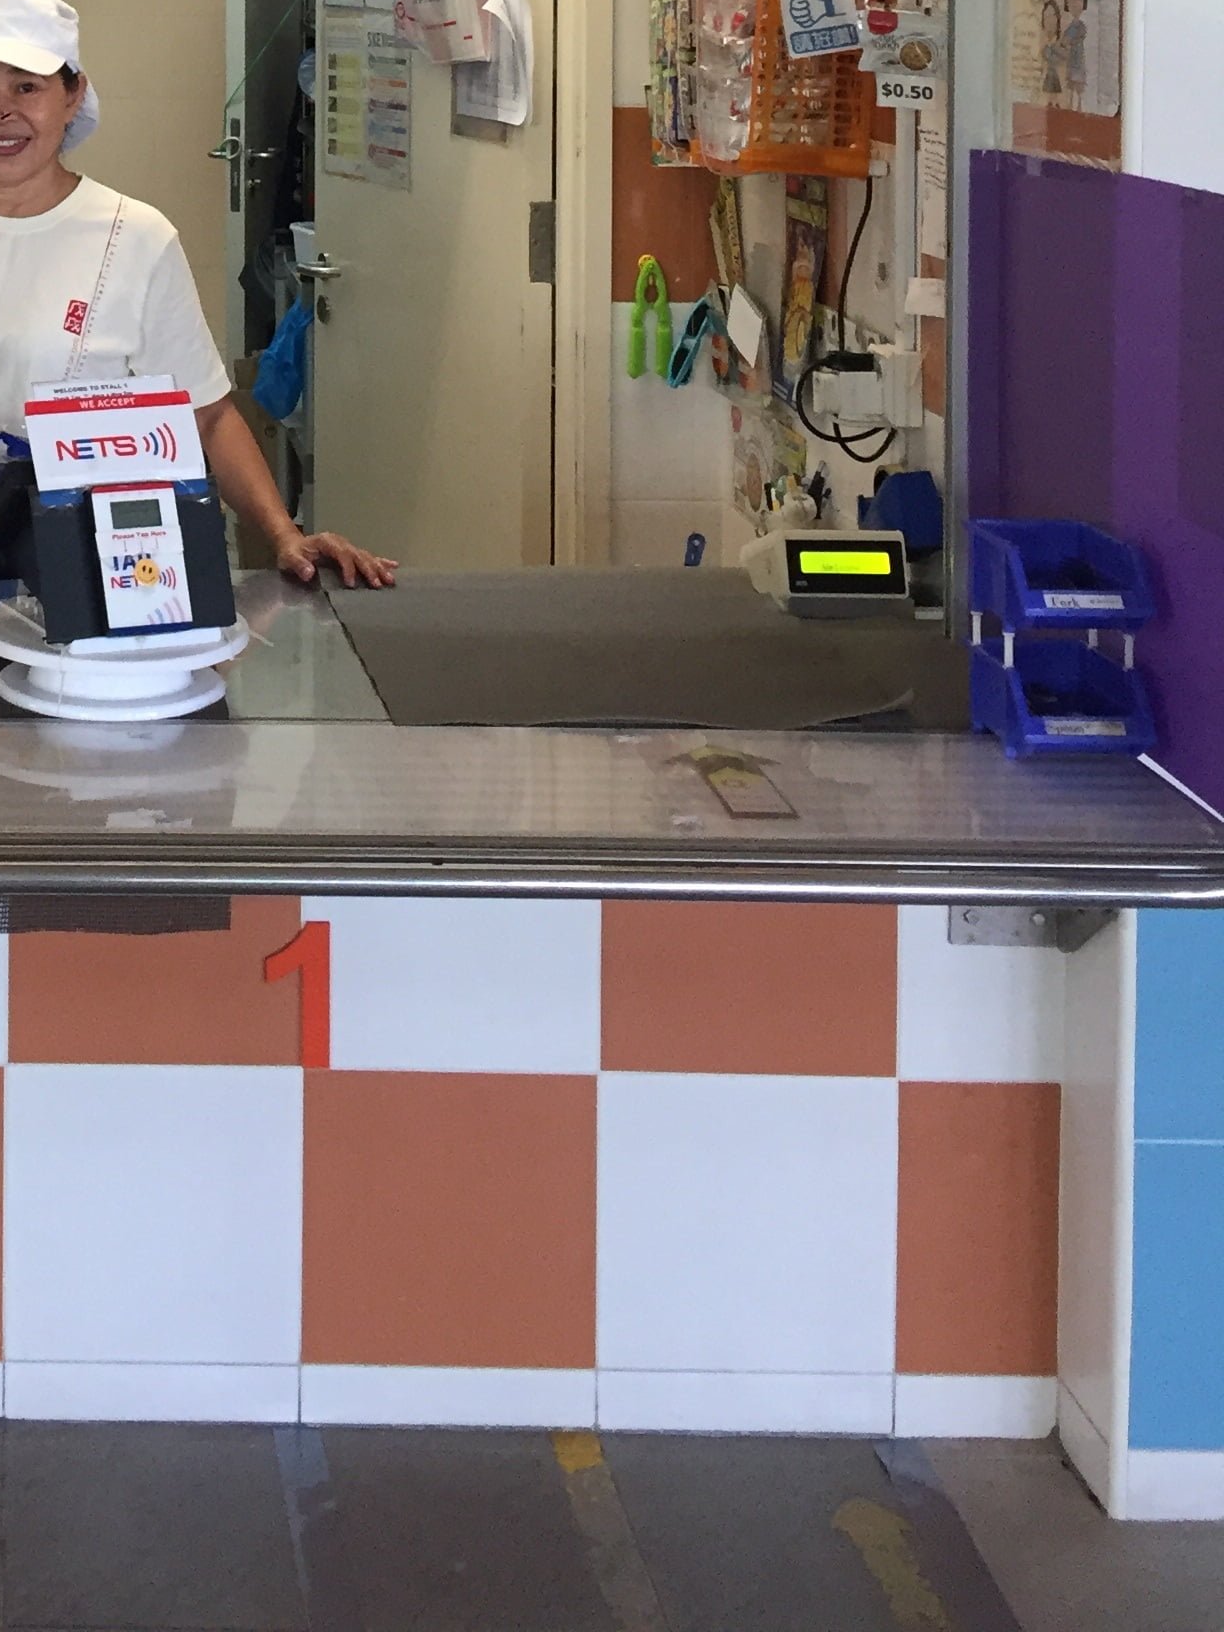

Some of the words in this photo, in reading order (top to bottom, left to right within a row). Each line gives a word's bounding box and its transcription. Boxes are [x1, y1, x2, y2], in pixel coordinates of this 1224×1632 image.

[881, 82, 933, 100] $0.50
[79, 399, 95, 409] WE
[97, 397, 136, 408] ACCEPT
[55, 435, 138, 462] NETS
[263, 921, 331, 1070] 1
